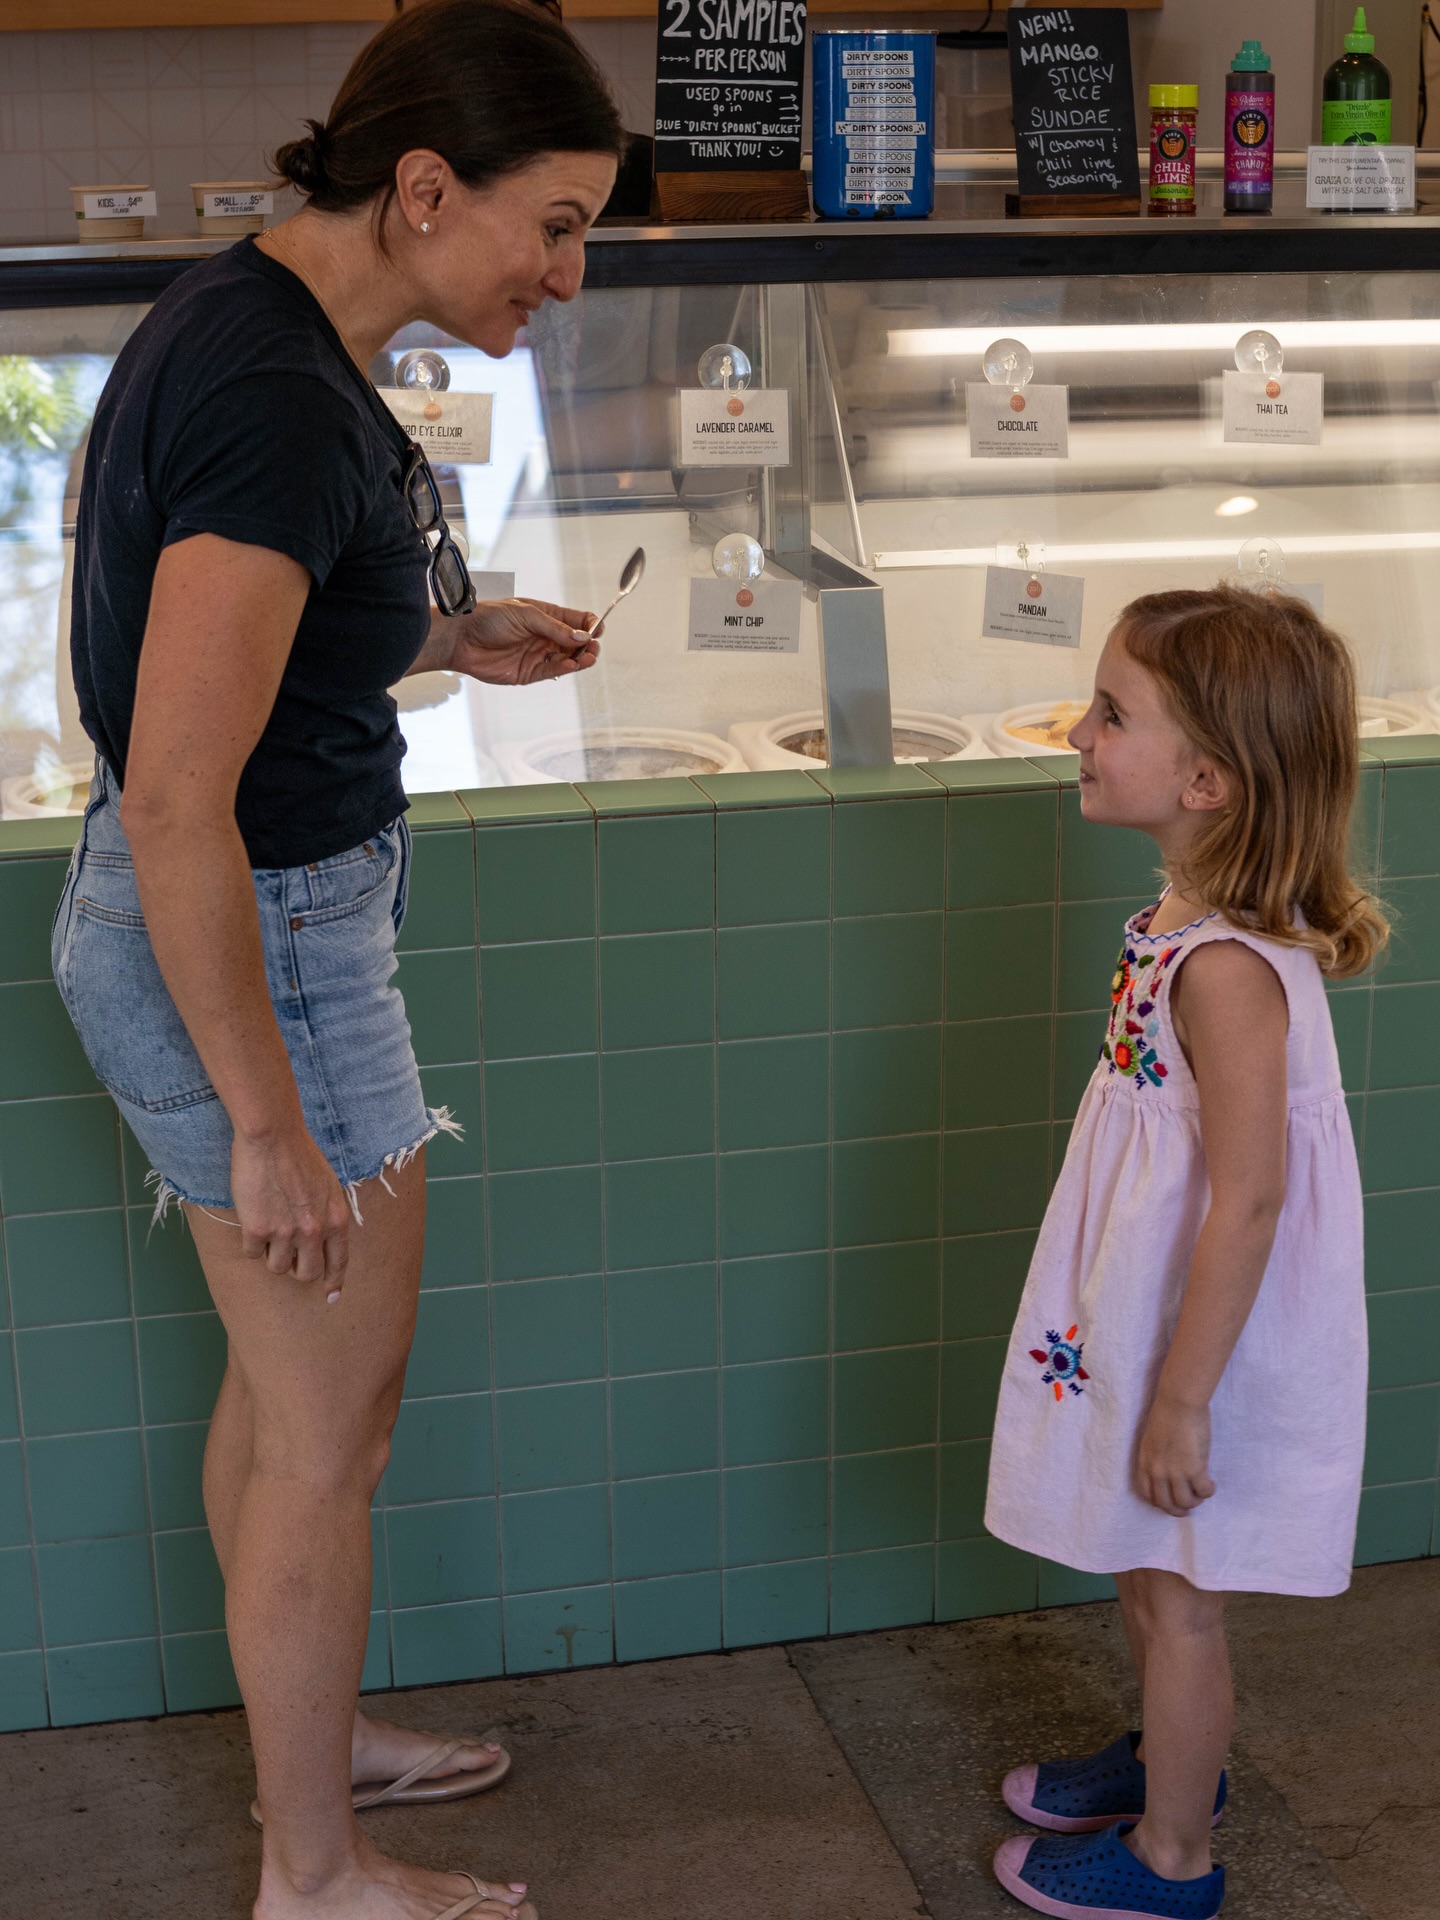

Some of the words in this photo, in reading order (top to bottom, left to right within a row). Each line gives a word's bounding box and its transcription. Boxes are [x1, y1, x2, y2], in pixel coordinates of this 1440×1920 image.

[662, 0, 692, 38] 2
[697, 0, 807, 46] SAMPLES
[1018, 9, 1075, 39] NEW!!
[847, 53, 871, 61] DIRTY
[873, 53, 909, 61] SPOONS
[1020, 43, 1099, 66] MANGO
[694, 49, 728, 72] PER
[729, 48, 787, 74] PERSON
[847, 68, 873, 76] DIRTY
[875, 67, 910, 75] SPOONS
[1047, 63, 1115, 86] STICKY
[851, 82, 876, 90] DIRTY
[878, 82, 912, 90] SPOONS
[685, 86, 720, 102] USED
[725, 87, 773, 103] SPOONS
[852, 96, 877, 104] DIRTY
[879, 96, 913, 104] SPOONS
[1054, 85, 1102, 103] RICE
[713, 103, 725, 117] go
[729, 102, 743, 112] in
[1031, 106, 1111, 129] SUNDAE
[655, 119, 682, 131] BLUE
[761, 123, 801, 135] BUCKET
[852, 124, 877, 132] DIRTY
[879, 124, 914, 132] SPOONS
[689, 141, 733, 158] THANK
[733, 141, 762, 159] YOU!
[853, 152, 877, 160] DIRTY
[879, 152, 913, 161] SPOONS
[850, 166, 875, 174] DIRTY
[876, 166, 911, 174] SPOONS
[1154, 162, 1191, 174] CHILE
[1157, 173, 1188, 184] LIME
[1379, 176, 1406, 184] DRZZLE
[850, 193, 874, 201] DIRTY
[1256, 403, 1273, 414] THAI
[1275, 404, 1289, 415] TEA
[419, 425, 435, 437] EYE
[437, 426, 463, 438] ELIXIR
[696, 422, 736, 433] LAVENDER
[738, 422, 774, 433] CARAMEL
[997, 420, 1038, 431] CHOCOLATE
[1017, 603, 1047, 617] PANDAN
[724, 616, 743, 626] MINT
[745, 616, 764, 627] CHIP
